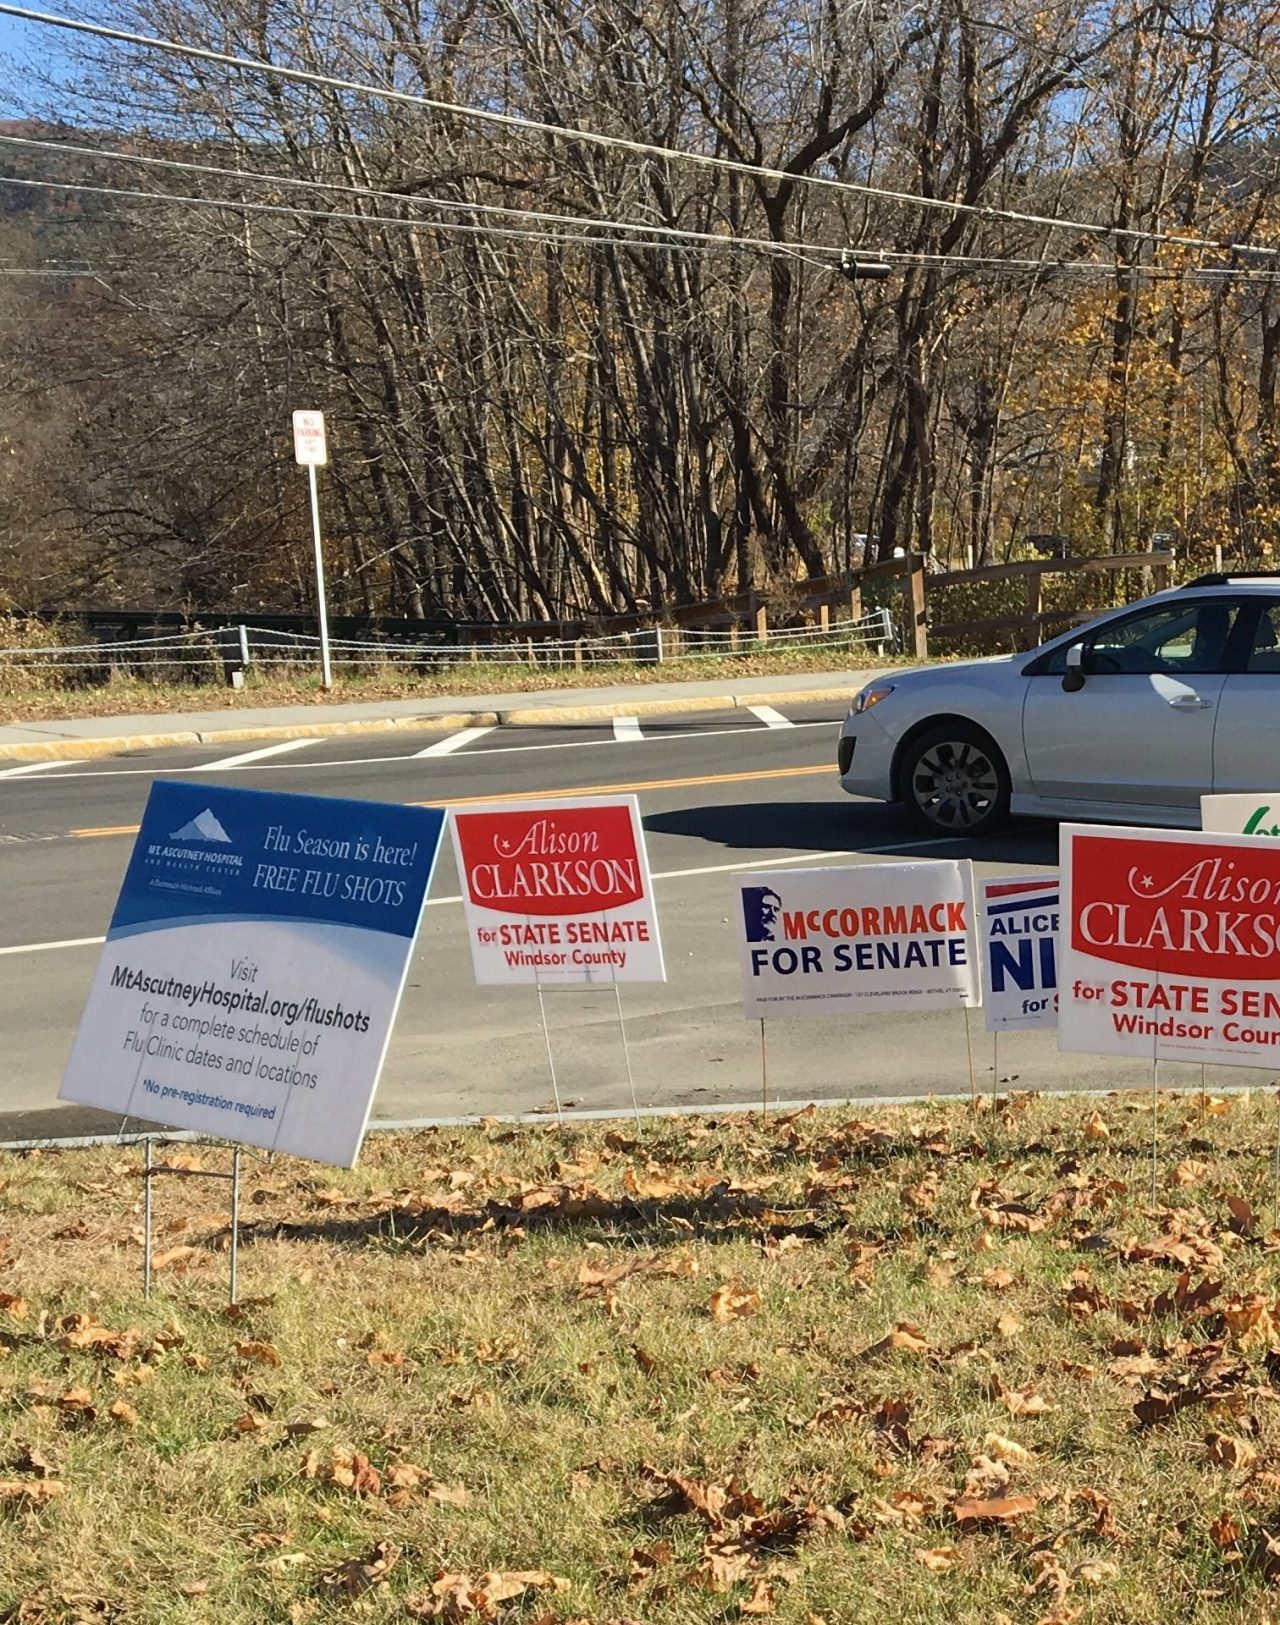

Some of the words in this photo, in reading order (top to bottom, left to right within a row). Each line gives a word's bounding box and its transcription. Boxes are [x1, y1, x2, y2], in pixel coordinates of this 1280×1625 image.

[161, 846, 205, 861] ASCUTNEY
[203, 851, 243, 867] HOSPITAL
[263, 825, 291, 852] Flu
[293, 828, 351, 859] Season
[353, 836, 370, 862] is
[372, 836, 418, 867] here!
[493, 819, 600, 859] Alison
[252, 863, 300, 892] FREE
[301, 869, 340, 898] FLU
[340, 874, 407, 907] SHOTS
[471, 858, 637, 899] CLARKSON
[477, 927, 497, 943] for
[499, 923, 561, 945] STATE
[568, 920, 650, 944] SENATE
[781, 902, 968, 941] McCORMACK
[990, 914, 1059, 936] ALICE
[229, 956, 259, 983] Visit
[504, 949, 567, 967] Windsor
[571, 949, 626, 968] County
[752, 946, 824, 976] FOR
[834, 938, 967, 972] SENATE
[110, 964, 371, 1033] MtAscutneyHospital.org/flushots
[1021, 998, 1049, 1014] for
[1072, 980, 1105, 1001] for
[1110, 980, 1209, 1014] STATE
[139, 1002, 160, 1024] for
[160, 1012, 169, 1026] a
[171, 1013, 235, 1041] complete
[237, 1025, 299, 1054] schedule
[302, 1034, 322, 1056] of
[1112, 1013, 1214, 1040] Windsor
[123, 1030, 142, 1053] Flu
[146, 1035, 182, 1062] Clinic
[185, 1044, 222, 1071] dates
[225, 1054, 255, 1077] and
[255, 1055, 318, 1090] locations
[160, 1084, 234, 1112] pre-registration
[234, 1101, 277, 1121] required
